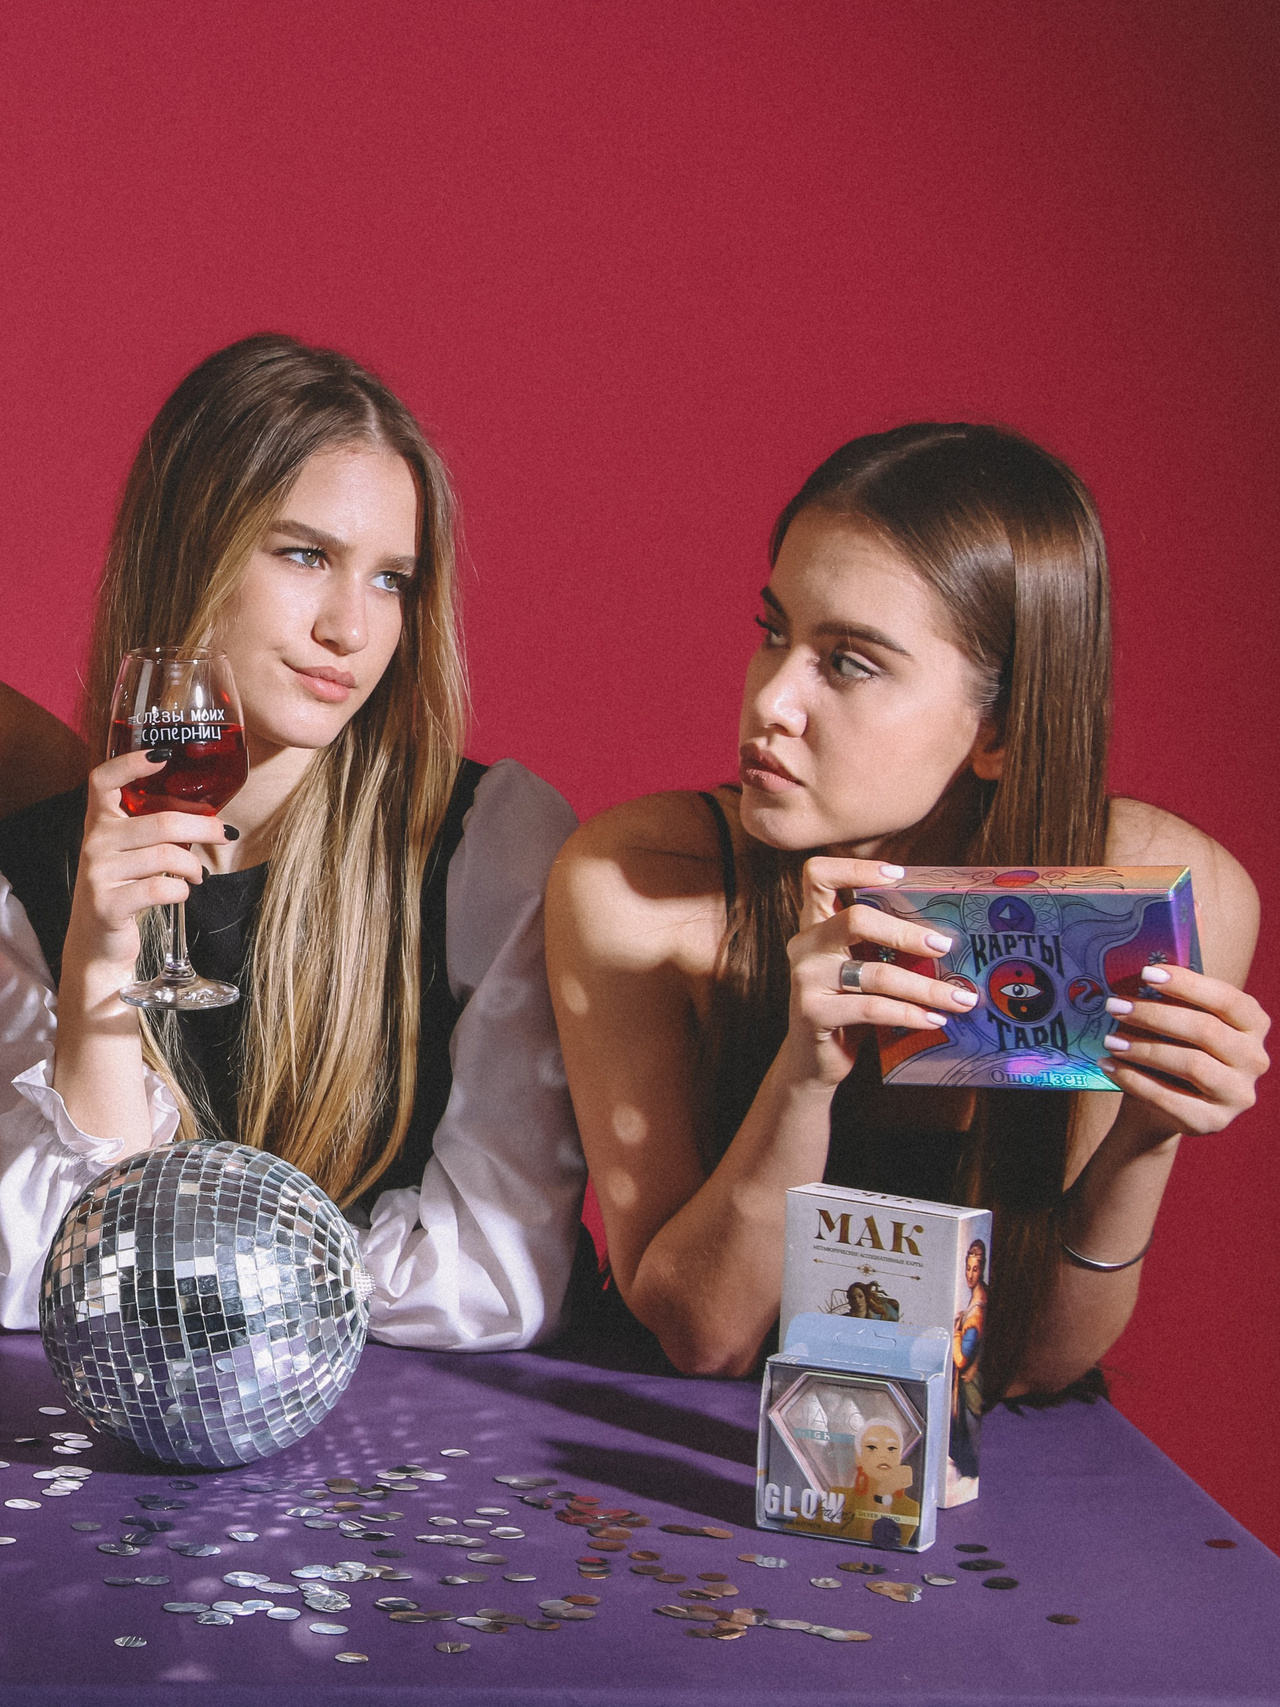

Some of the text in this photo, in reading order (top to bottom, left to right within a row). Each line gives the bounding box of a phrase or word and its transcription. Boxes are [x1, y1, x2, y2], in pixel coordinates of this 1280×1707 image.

[142, 726, 222, 746] соперниц
[190, 708, 225, 722] моих
[969, 933, 1066, 978] КАРТЫ
[986, 1010, 1068, 1052] ТАРО
[814, 1208, 925, 1257] МАК
[764, 1482, 846, 1525] GLOW
